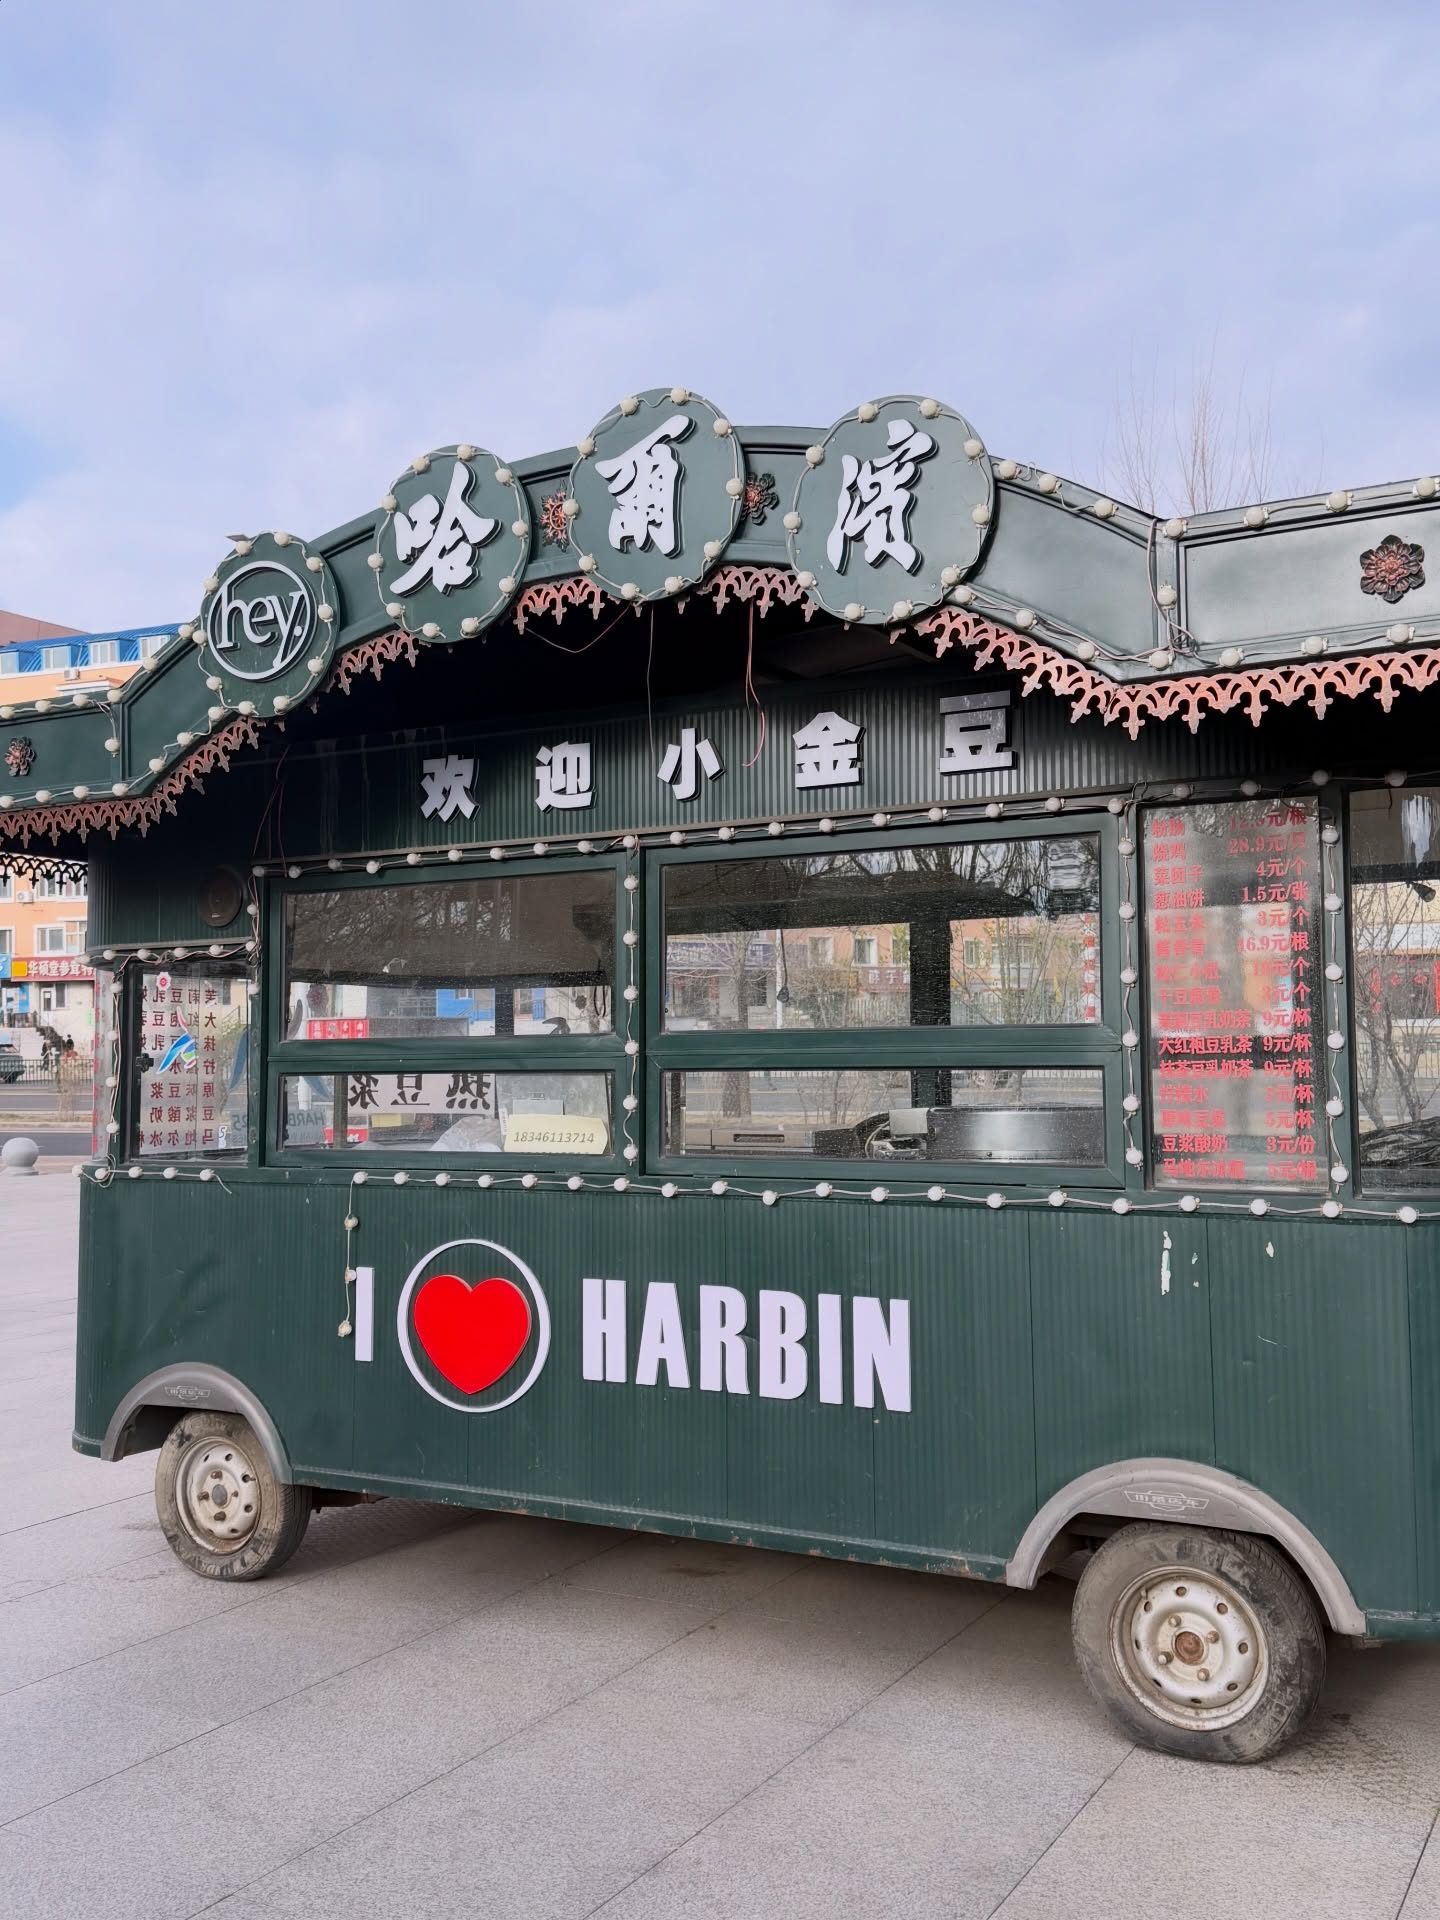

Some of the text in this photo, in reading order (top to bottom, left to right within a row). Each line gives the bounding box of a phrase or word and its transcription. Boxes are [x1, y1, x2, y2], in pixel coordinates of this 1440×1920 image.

[421, 690, 1017, 824] 欢迎小金豆
[1255, 856, 1308, 878] 4元/个
[1154, 881, 1309, 910] 葱油饼 1.5元/张
[1257, 906, 1309, 926] 3元/个
[1262, 1007, 1313, 1028] 9元/杯
[1158, 1033, 1313, 1055] 大红袍豆乳茶 9元/杯
[1159, 1058, 1313, 1079] 抹茶豆乳奶茶 9元/杯
[513, 1131, 595, 1144] 18346113714
[1162, 1133, 1316, 1155] 豆浆酸奶 3元/份
[355, 1266, 912, 1412] I HARBIN
